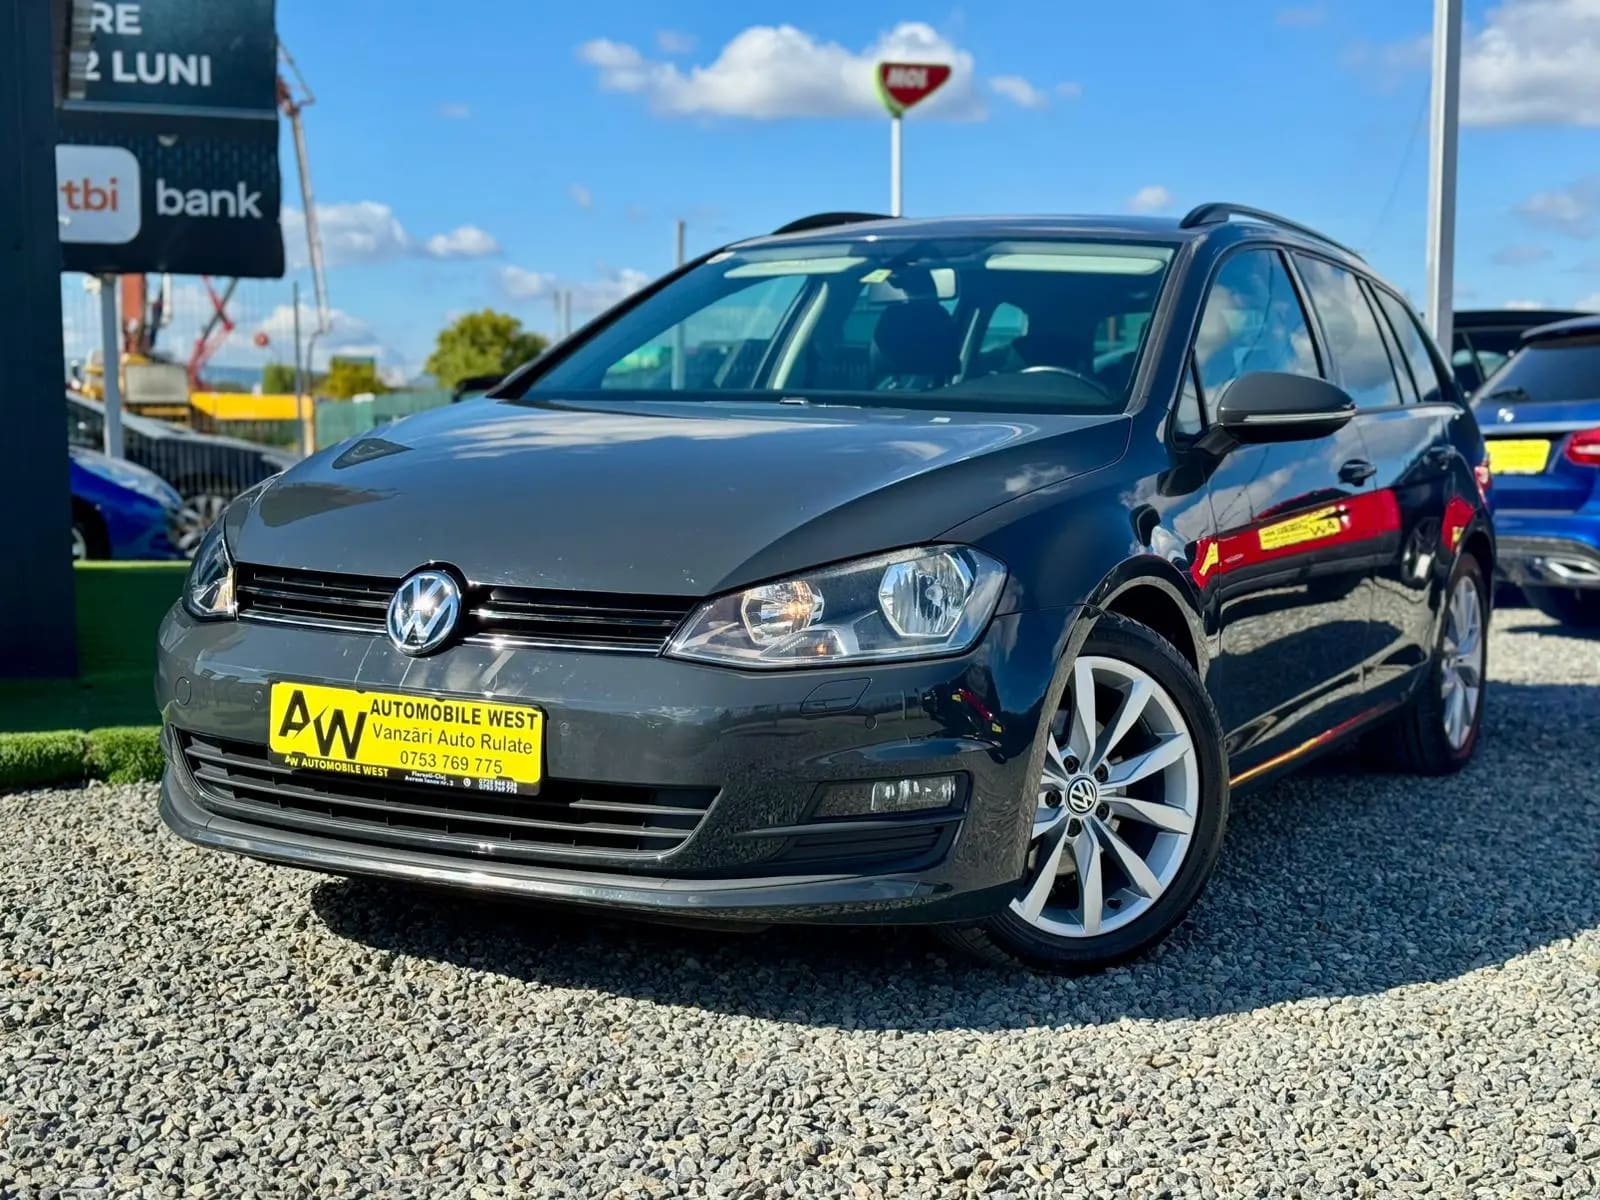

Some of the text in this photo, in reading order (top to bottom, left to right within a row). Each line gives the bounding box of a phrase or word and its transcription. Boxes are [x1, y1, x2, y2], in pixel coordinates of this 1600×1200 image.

[90, 2, 142, 35] RE
[112, 50, 212, 86] LUNI
[60, 177, 119, 212] tbi
[156, 178, 262, 218] bank
[370, 699, 538, 731] AUTOMOBILE WEST
[437, 730, 475, 749] Auto
[481, 733, 533, 755] Rulate
[301, 758, 361, 774] AUTOMOBILE
[363, 765, 390, 778] WEST
[400, 750, 503, 775] 0753 769 775
